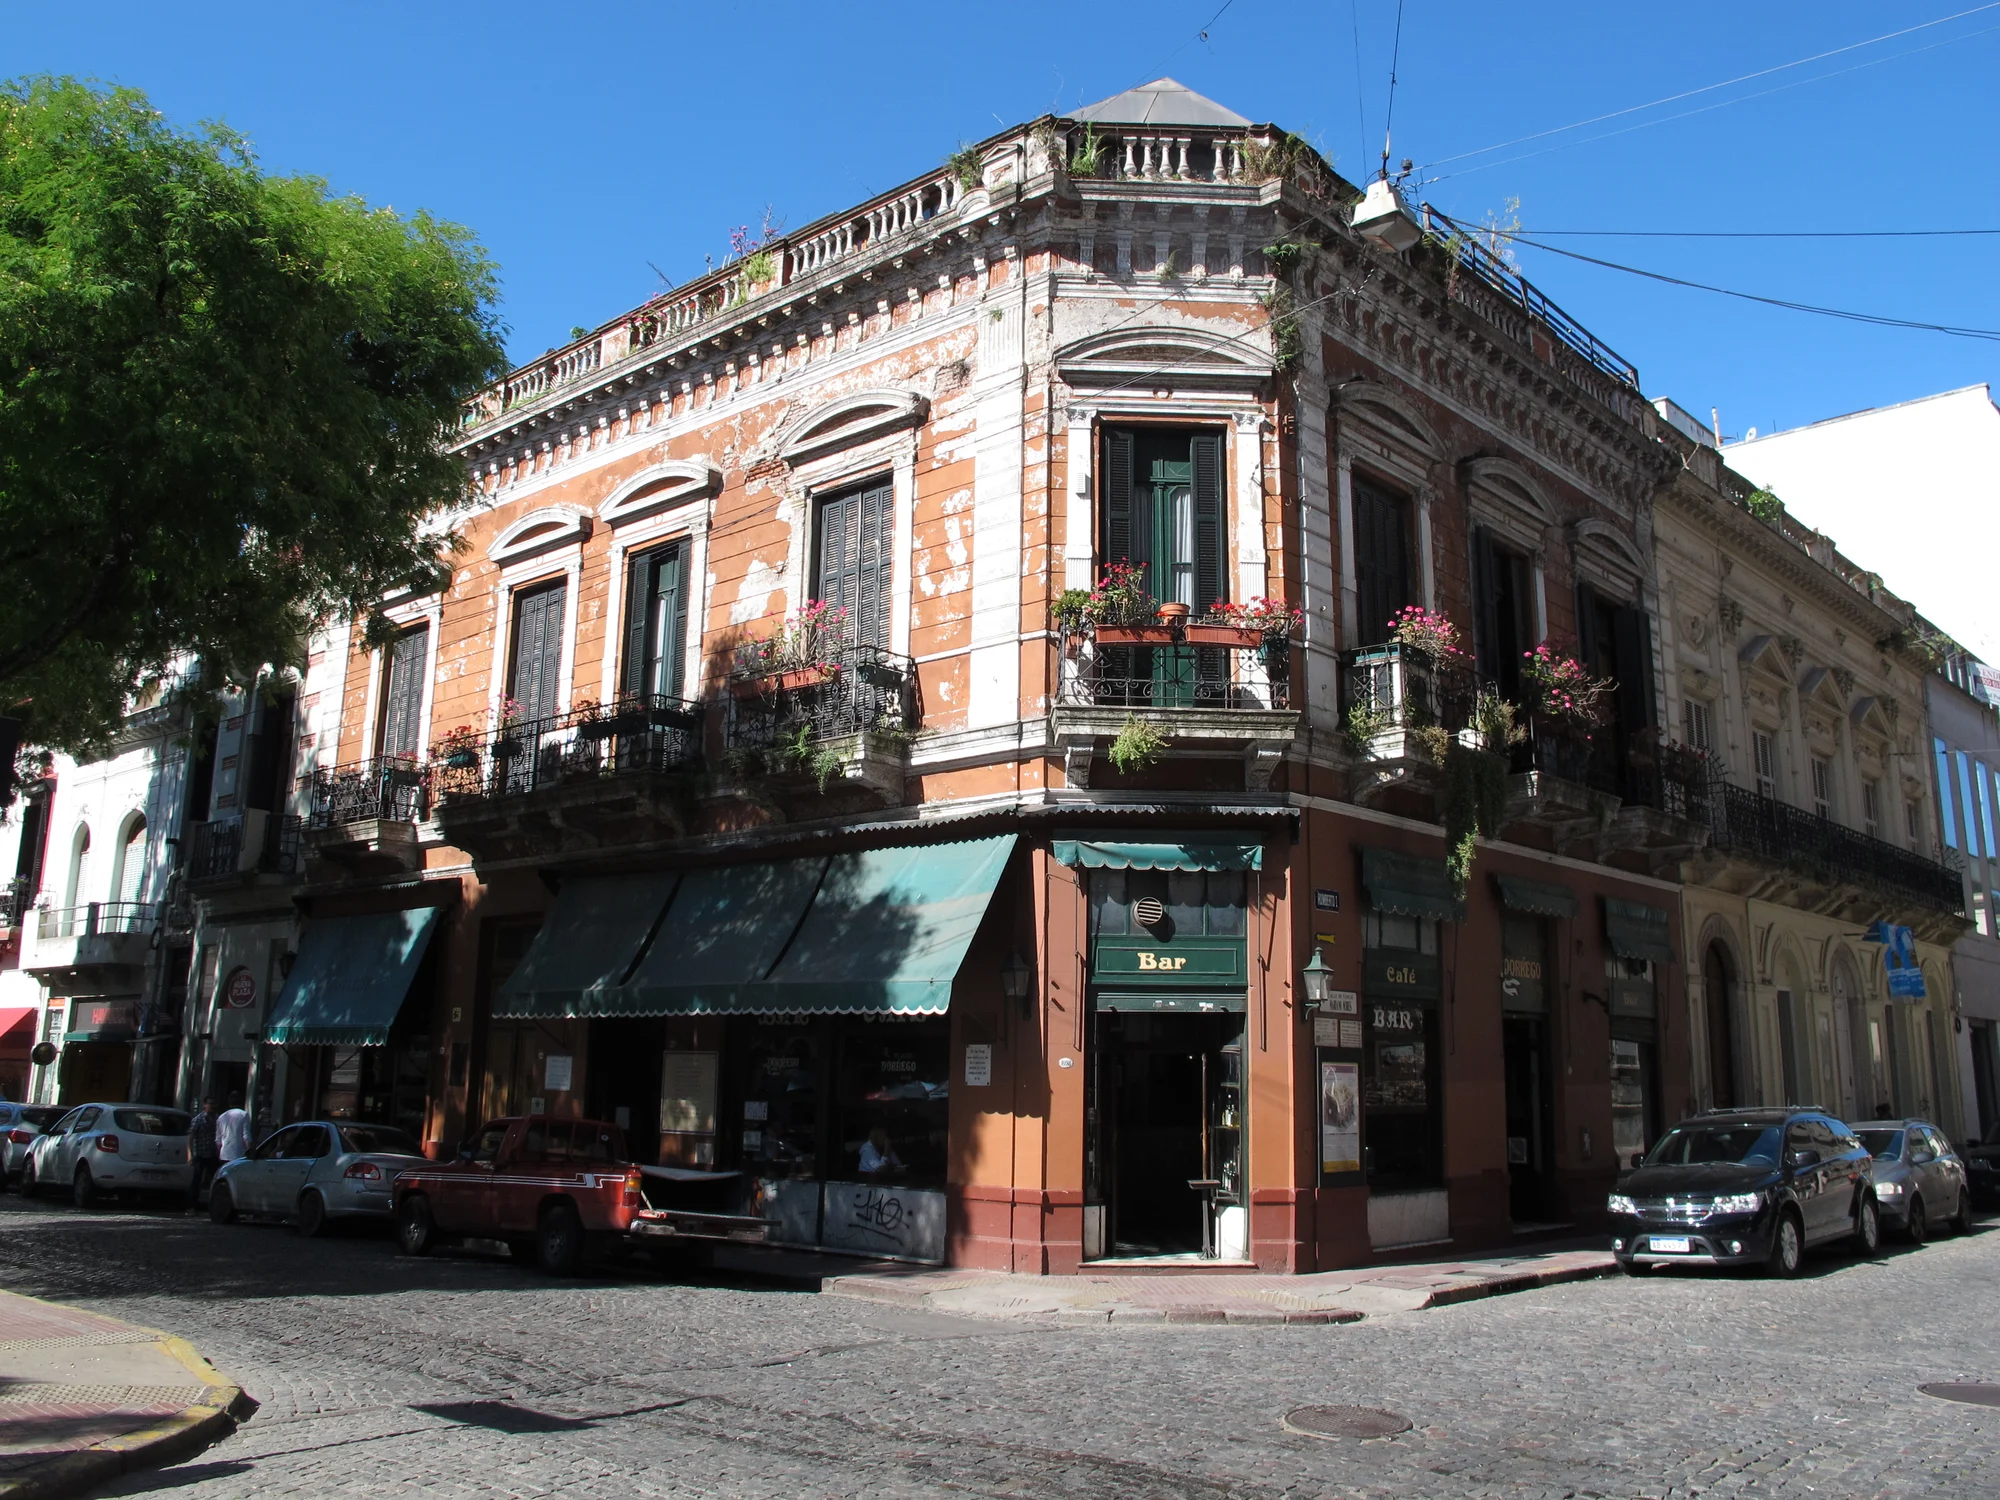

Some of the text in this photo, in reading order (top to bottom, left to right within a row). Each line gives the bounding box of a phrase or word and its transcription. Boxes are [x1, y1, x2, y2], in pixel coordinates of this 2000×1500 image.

[1137, 952, 1187, 970] Bar
[1386, 966, 1416, 984] Café
[233, 987, 251, 996] PLAZA
[1372, 1008, 1414, 1029] BAR
